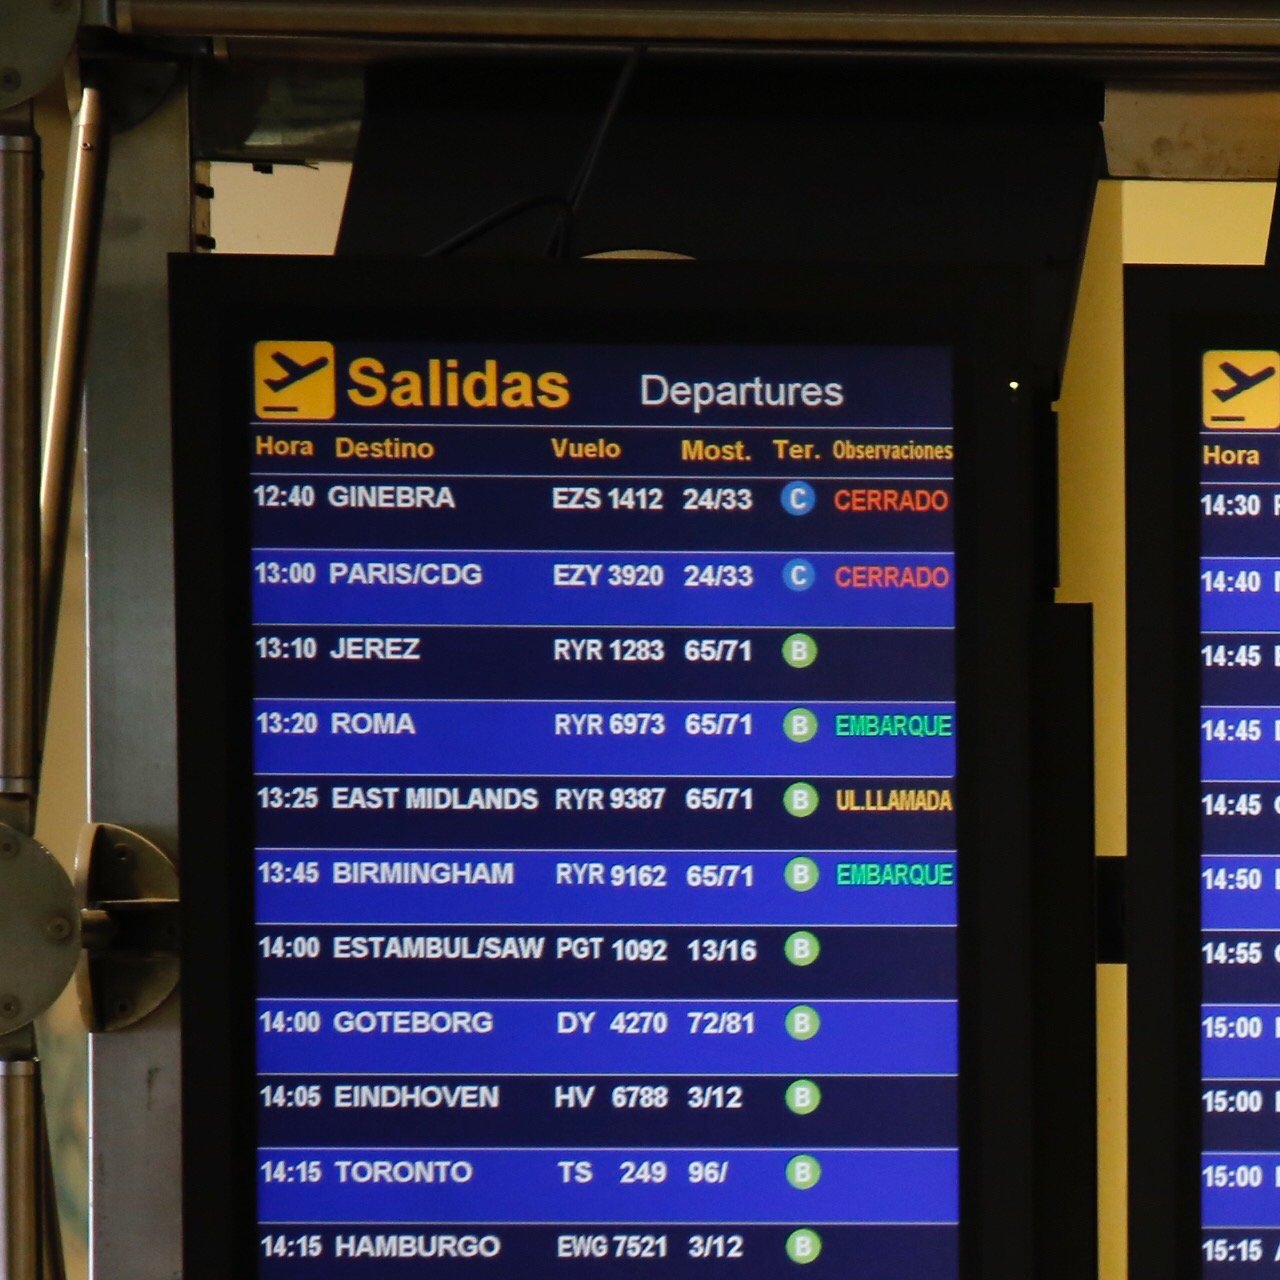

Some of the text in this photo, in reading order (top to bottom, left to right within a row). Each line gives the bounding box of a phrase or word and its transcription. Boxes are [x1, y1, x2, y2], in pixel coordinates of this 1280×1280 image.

[347, 357, 571, 409] Salidas
[641, 374, 844, 414] Departures
[255, 435, 955, 462] Hora Destino Vuelo Most. Ter. Observaciones
[1202, 444, 1261, 467] Hora
[254, 484, 949, 512] 12:40 GINEBRA EZS 1412 24/33 C CERRADO
[1201, 570, 1261, 593] 14:40
[258, 786, 953, 811] 13:25 EAST MIDLANDS RYR 9387 65/71 B UL.LLAMADA
[1202, 868, 1262, 890] 14:50
[260, 1085, 811, 1109] 14:05 EINDHOVEN HV 6788 3/12 B
[1202, 1165, 1263, 1188] 15:00
